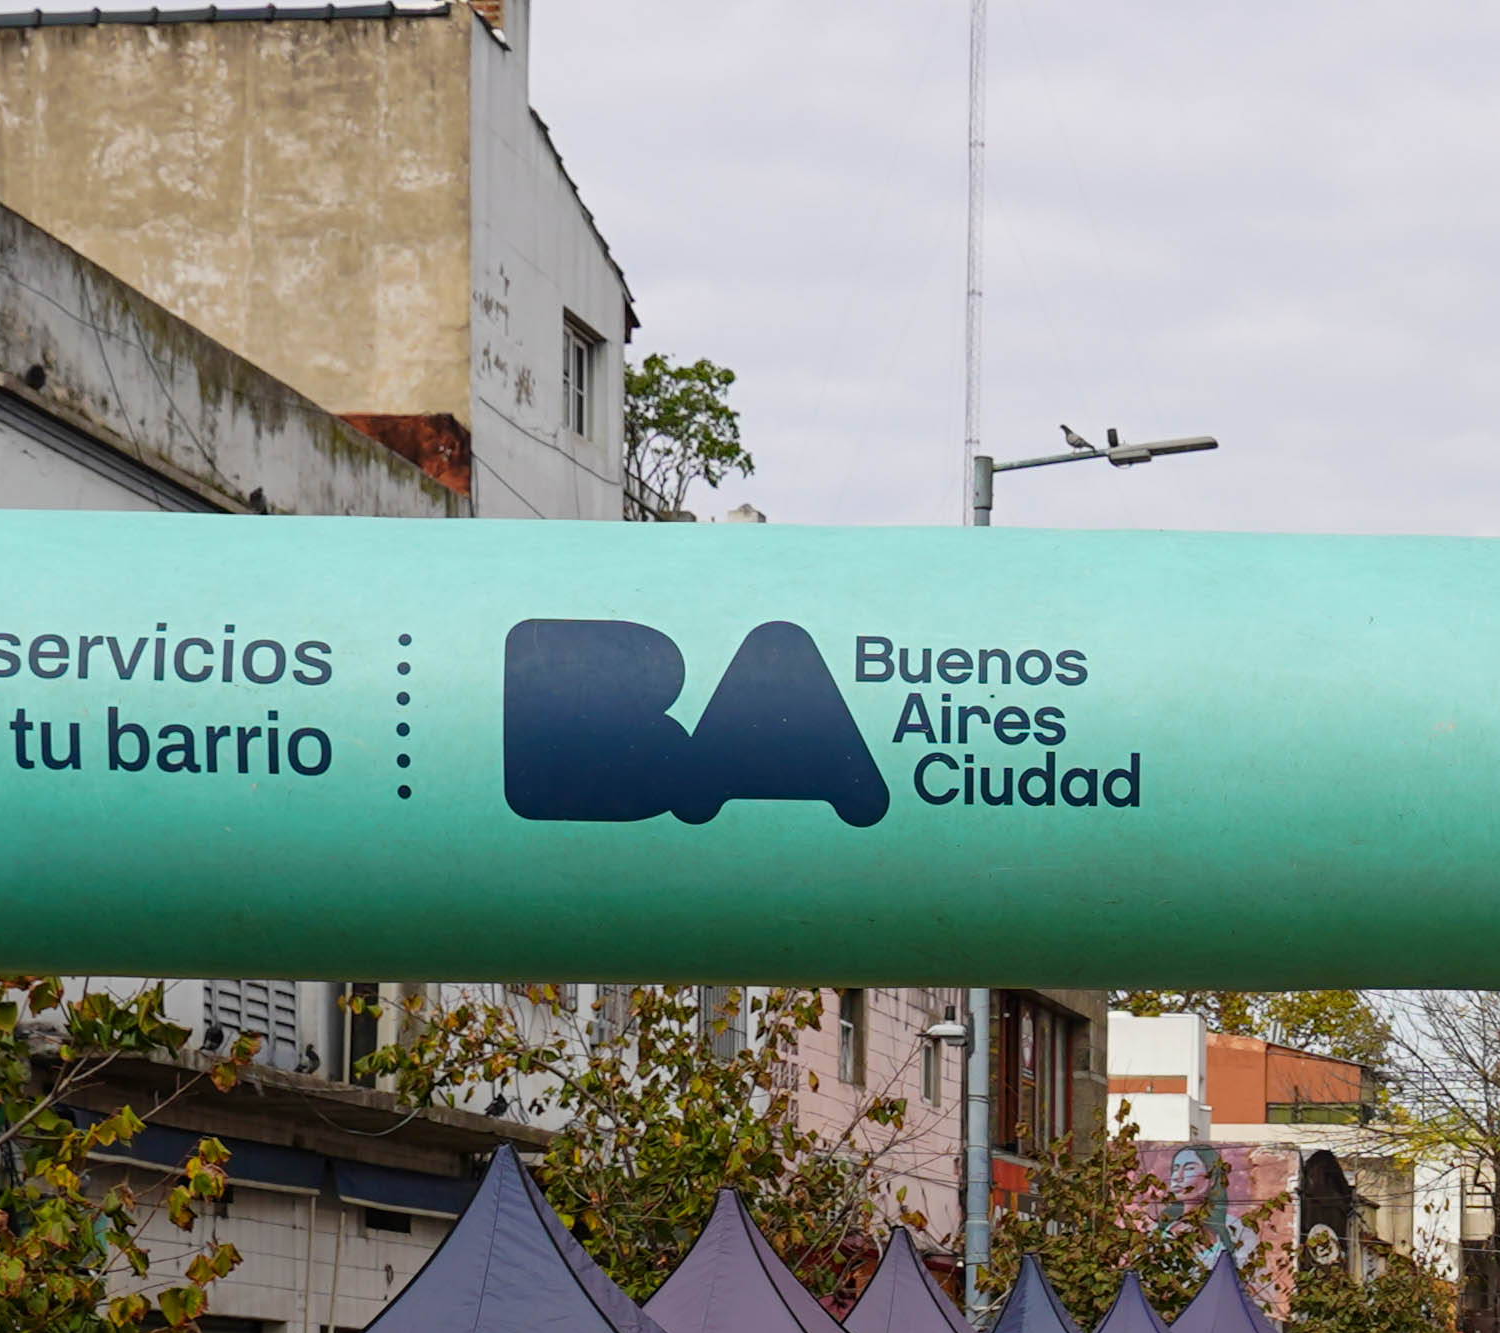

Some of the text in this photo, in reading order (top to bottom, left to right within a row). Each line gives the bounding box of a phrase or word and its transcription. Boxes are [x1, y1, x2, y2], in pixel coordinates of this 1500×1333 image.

[855, 635, 1089, 686] Buenos
[9, 708, 82, 770] tu
[107, 706, 333, 777] barrio
[504, 618, 890, 828] BA
[892, 692, 1067, 746] Aires
[912, 752, 1140, 808] Ciudad
